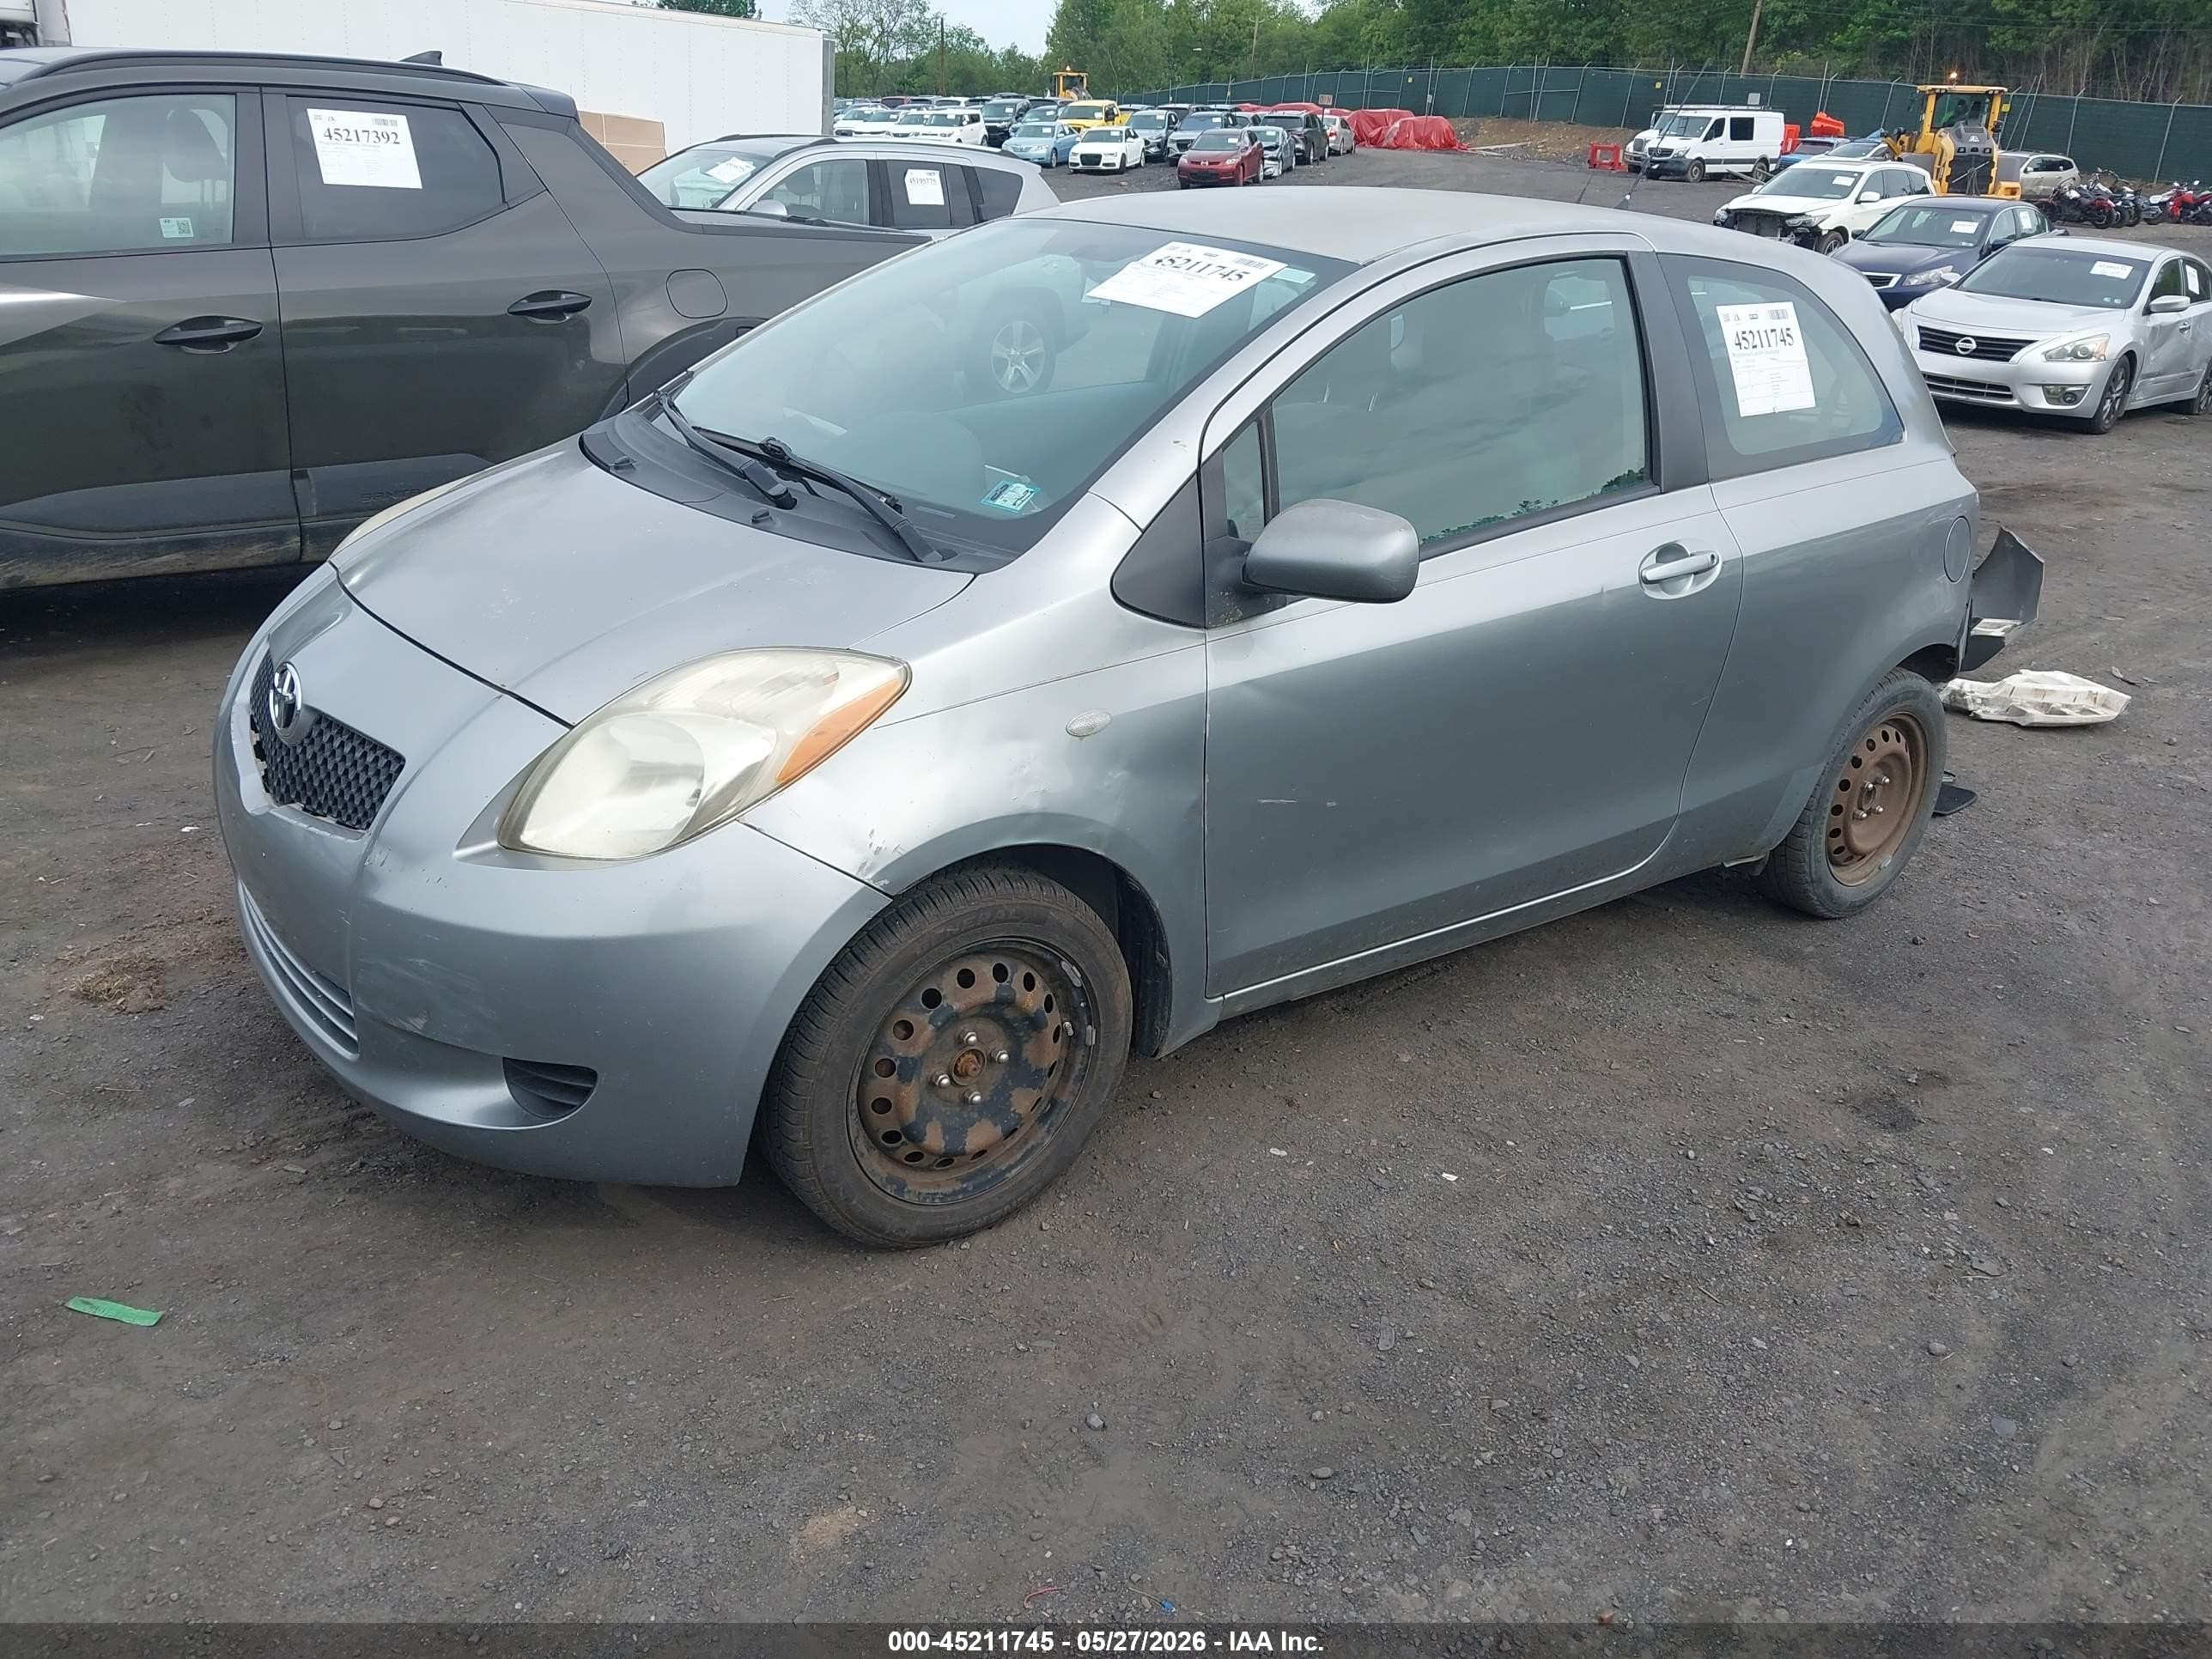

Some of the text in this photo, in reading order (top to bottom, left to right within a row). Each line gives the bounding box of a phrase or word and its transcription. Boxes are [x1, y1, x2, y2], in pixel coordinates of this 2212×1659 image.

[324, 127, 401, 145] 45217392
[1154, 255, 1250, 282] 45211745
[1735, 326, 1795, 350] 45211745
